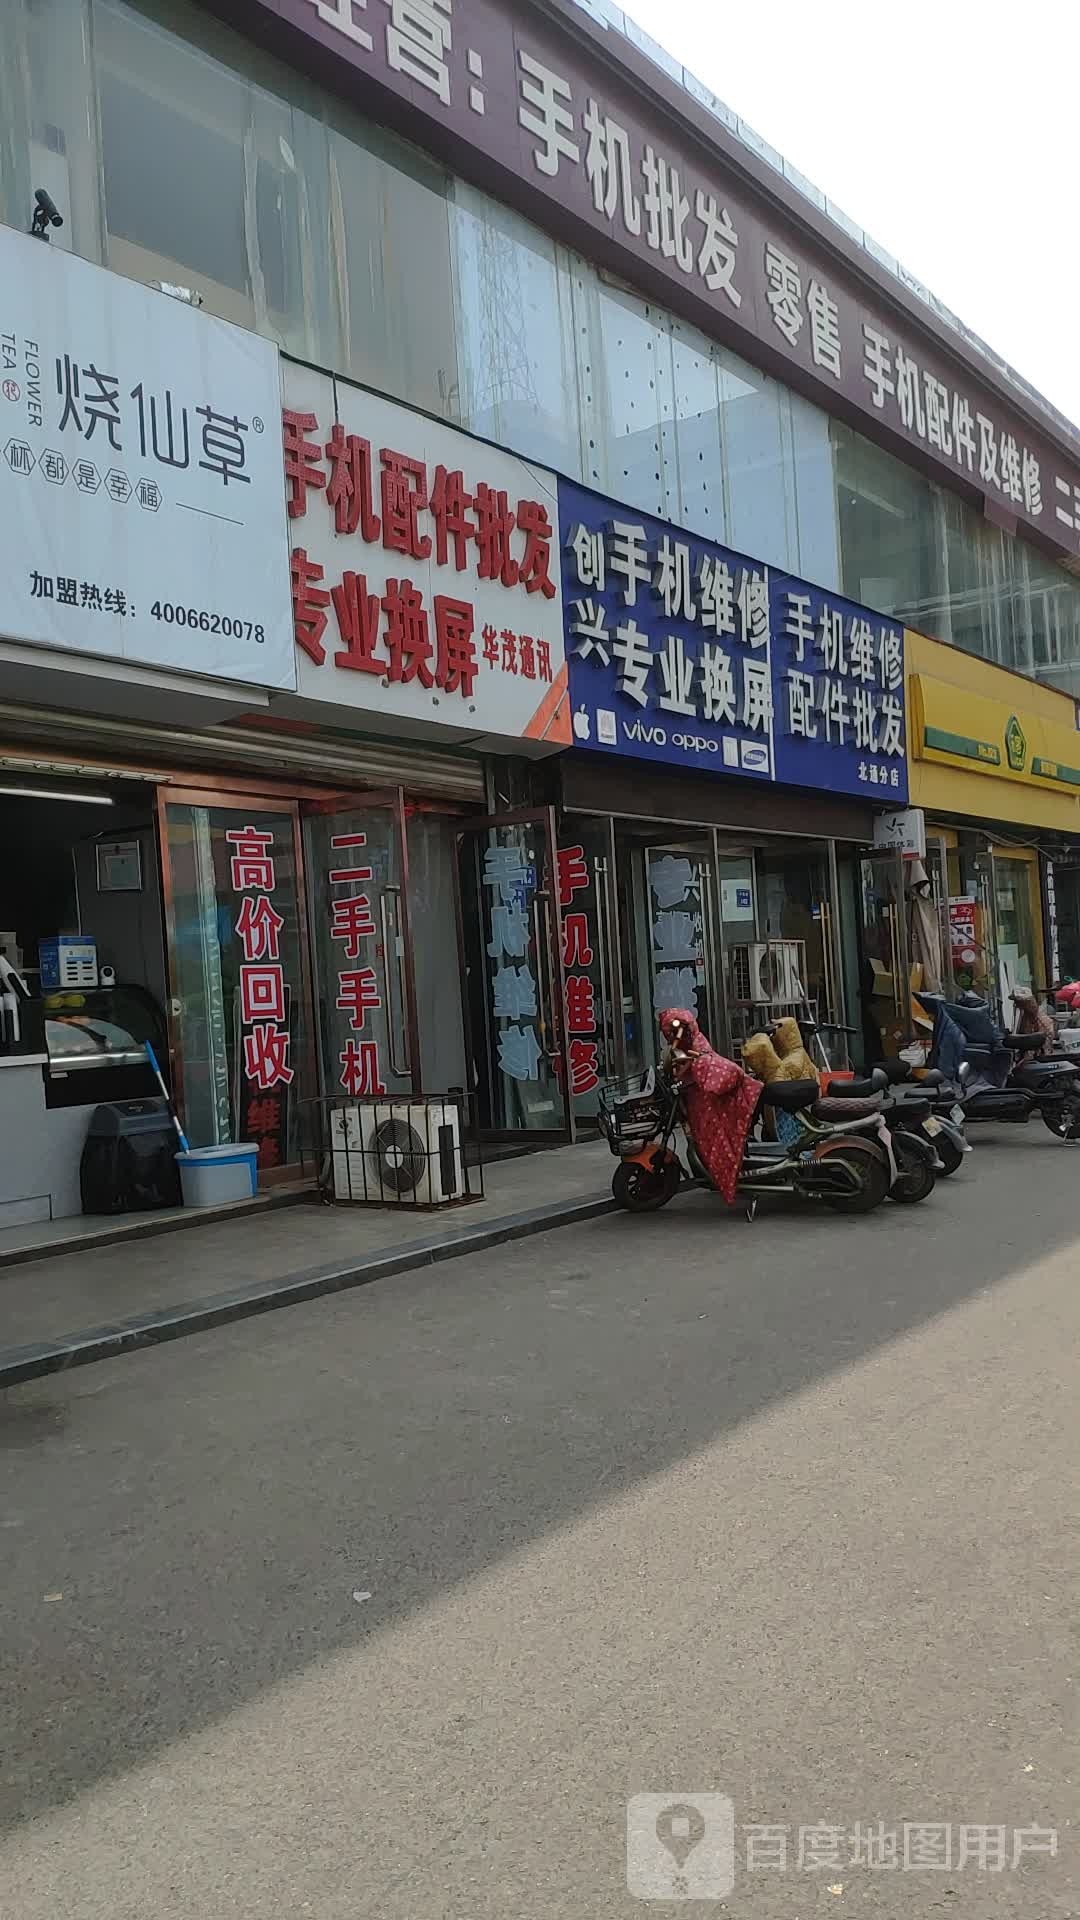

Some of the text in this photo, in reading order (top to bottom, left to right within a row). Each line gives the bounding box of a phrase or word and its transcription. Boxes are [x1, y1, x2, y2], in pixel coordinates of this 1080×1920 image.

[518, 49, 742, 309] 手机批发
[765, 242, 842, 380] 零售
[861, 323, 1043, 516] 手机配件及维修
[1, 332, 17, 370] TEA
[24, 338, 43, 427] FLOWER
[282, 407, 557, 601] 手机配件批发
[150, 602, 266, 644] 4006620078
[290, 547, 480, 698] 专业换屏
[609, 519, 771, 650] 手机维修
[481, 621, 553, 684] 华茂通讯
[612, 619, 774, 735] 专业换屏
[785, 591, 903, 692] 手机维修
[622, 718, 667, 746] vivo
[786, 668, 905, 758] 配件批发
[225, 826, 295, 1090] 高价回收
[328, 831, 387, 1096] 二手手机
